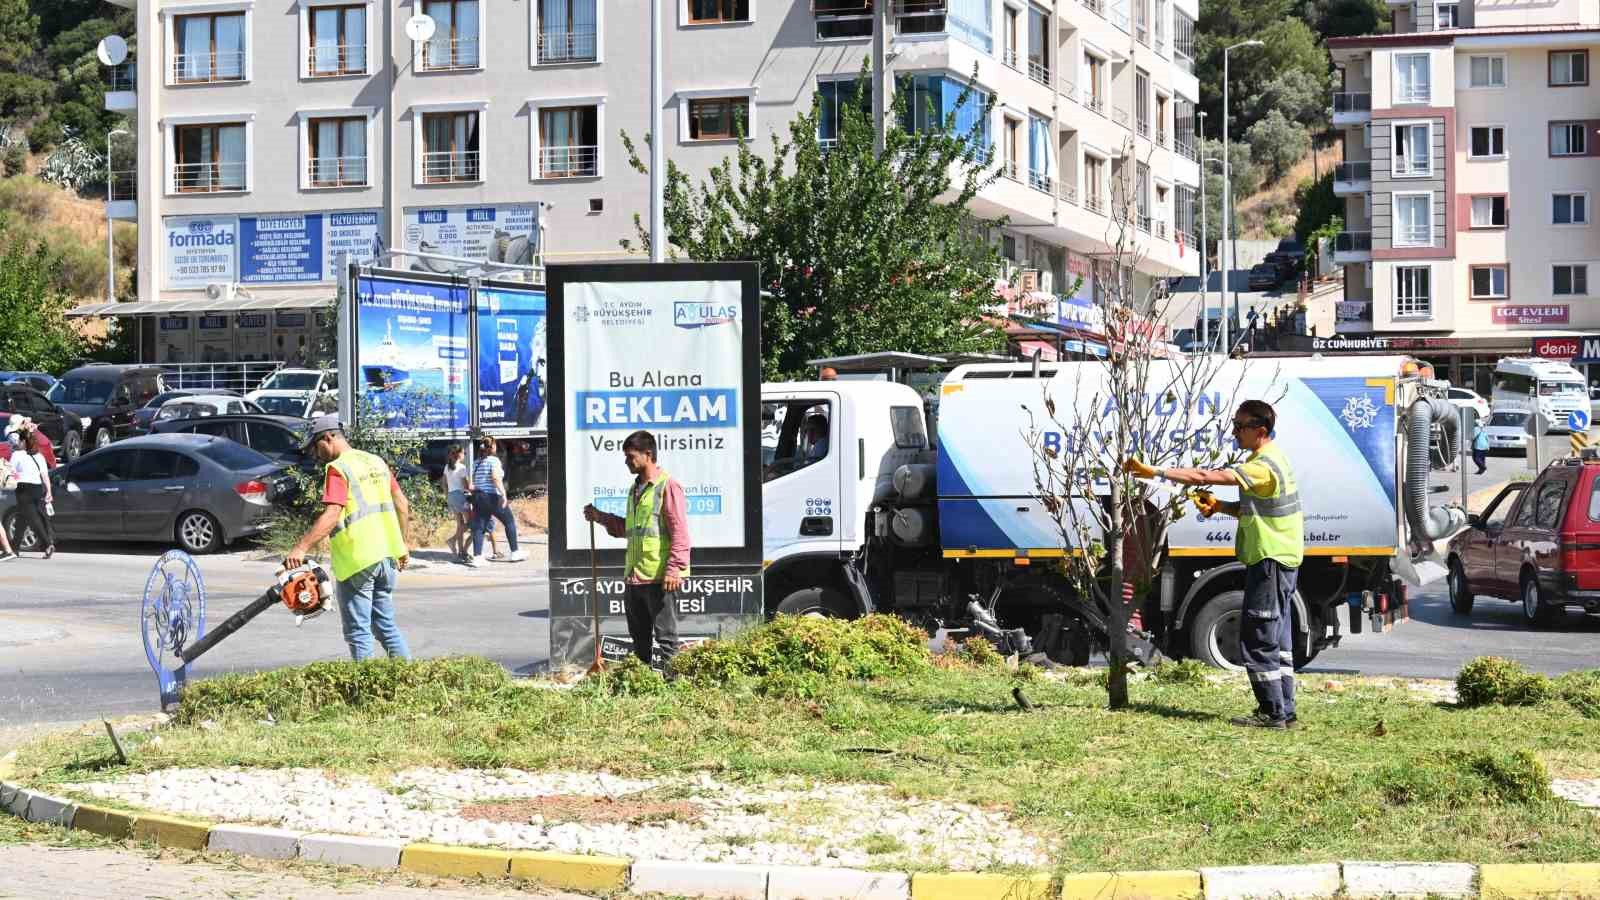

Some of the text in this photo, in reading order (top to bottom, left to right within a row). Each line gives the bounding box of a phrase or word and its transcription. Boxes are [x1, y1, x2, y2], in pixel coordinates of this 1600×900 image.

[168, 229, 235, 247] formada
[1497, 308, 1519, 316] EGE
[1312, 337, 1326, 349] ÖZ
[1327, 336, 1388, 348] CUMHURİYET
[1540, 342, 1578, 355] deniz
[610, 371, 703, 388] Bu Alana
[585, 395, 727, 424] REKLAM
[590, 433, 724, 451] Verlirsiniz
[1206, 531, 1232, 542] 444
[596, 580, 626, 594] AYD
[681, 577, 754, 596] ÜKŞEHİR
